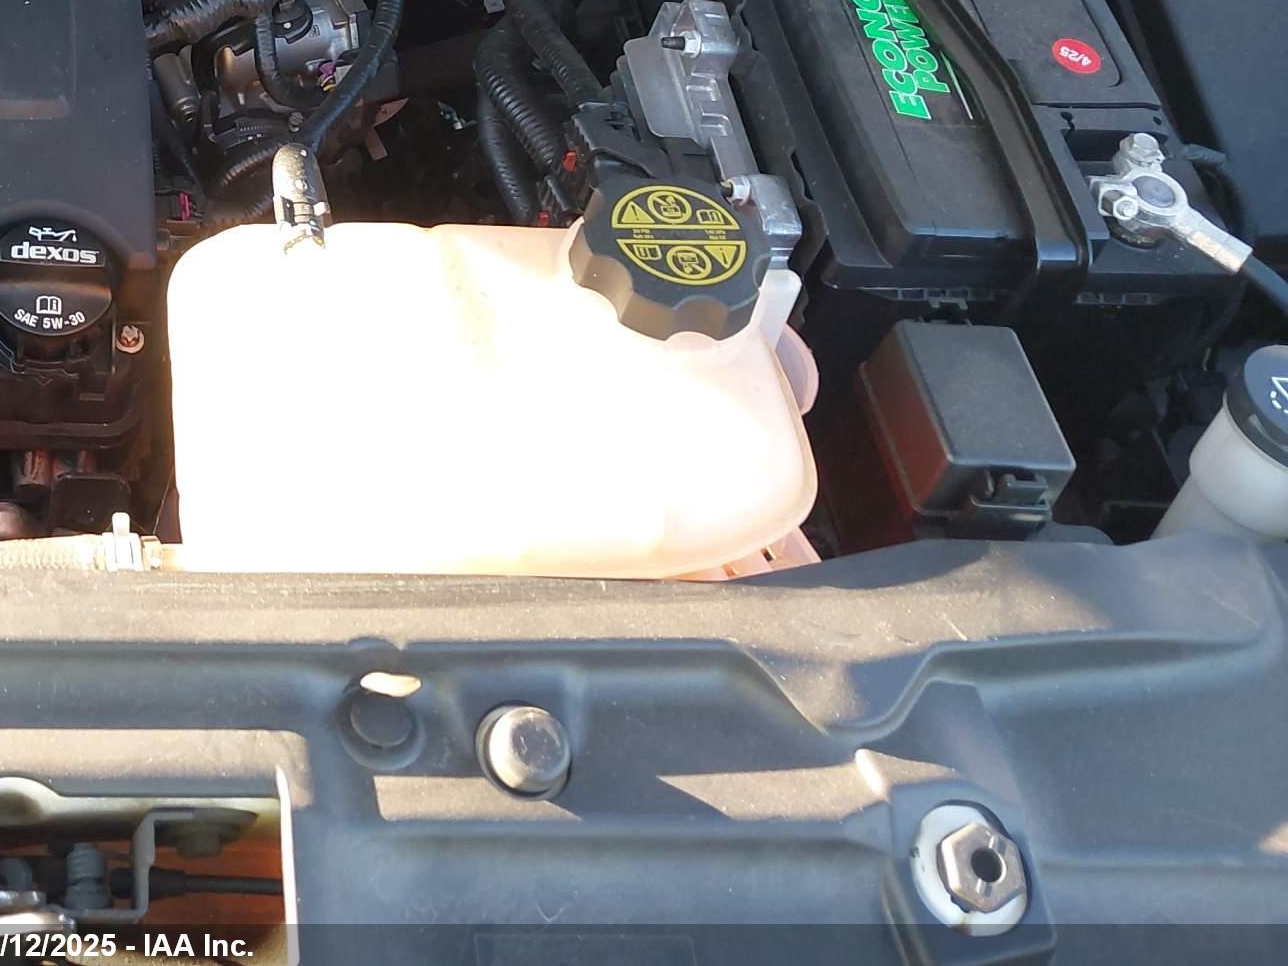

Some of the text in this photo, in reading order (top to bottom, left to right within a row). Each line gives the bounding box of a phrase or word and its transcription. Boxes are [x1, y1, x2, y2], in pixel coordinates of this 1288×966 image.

[1059, 45, 1093, 67] 4/25
[11, 241, 97, 264] dexos
[14, 308, 86, 329] SAE 5W-30
